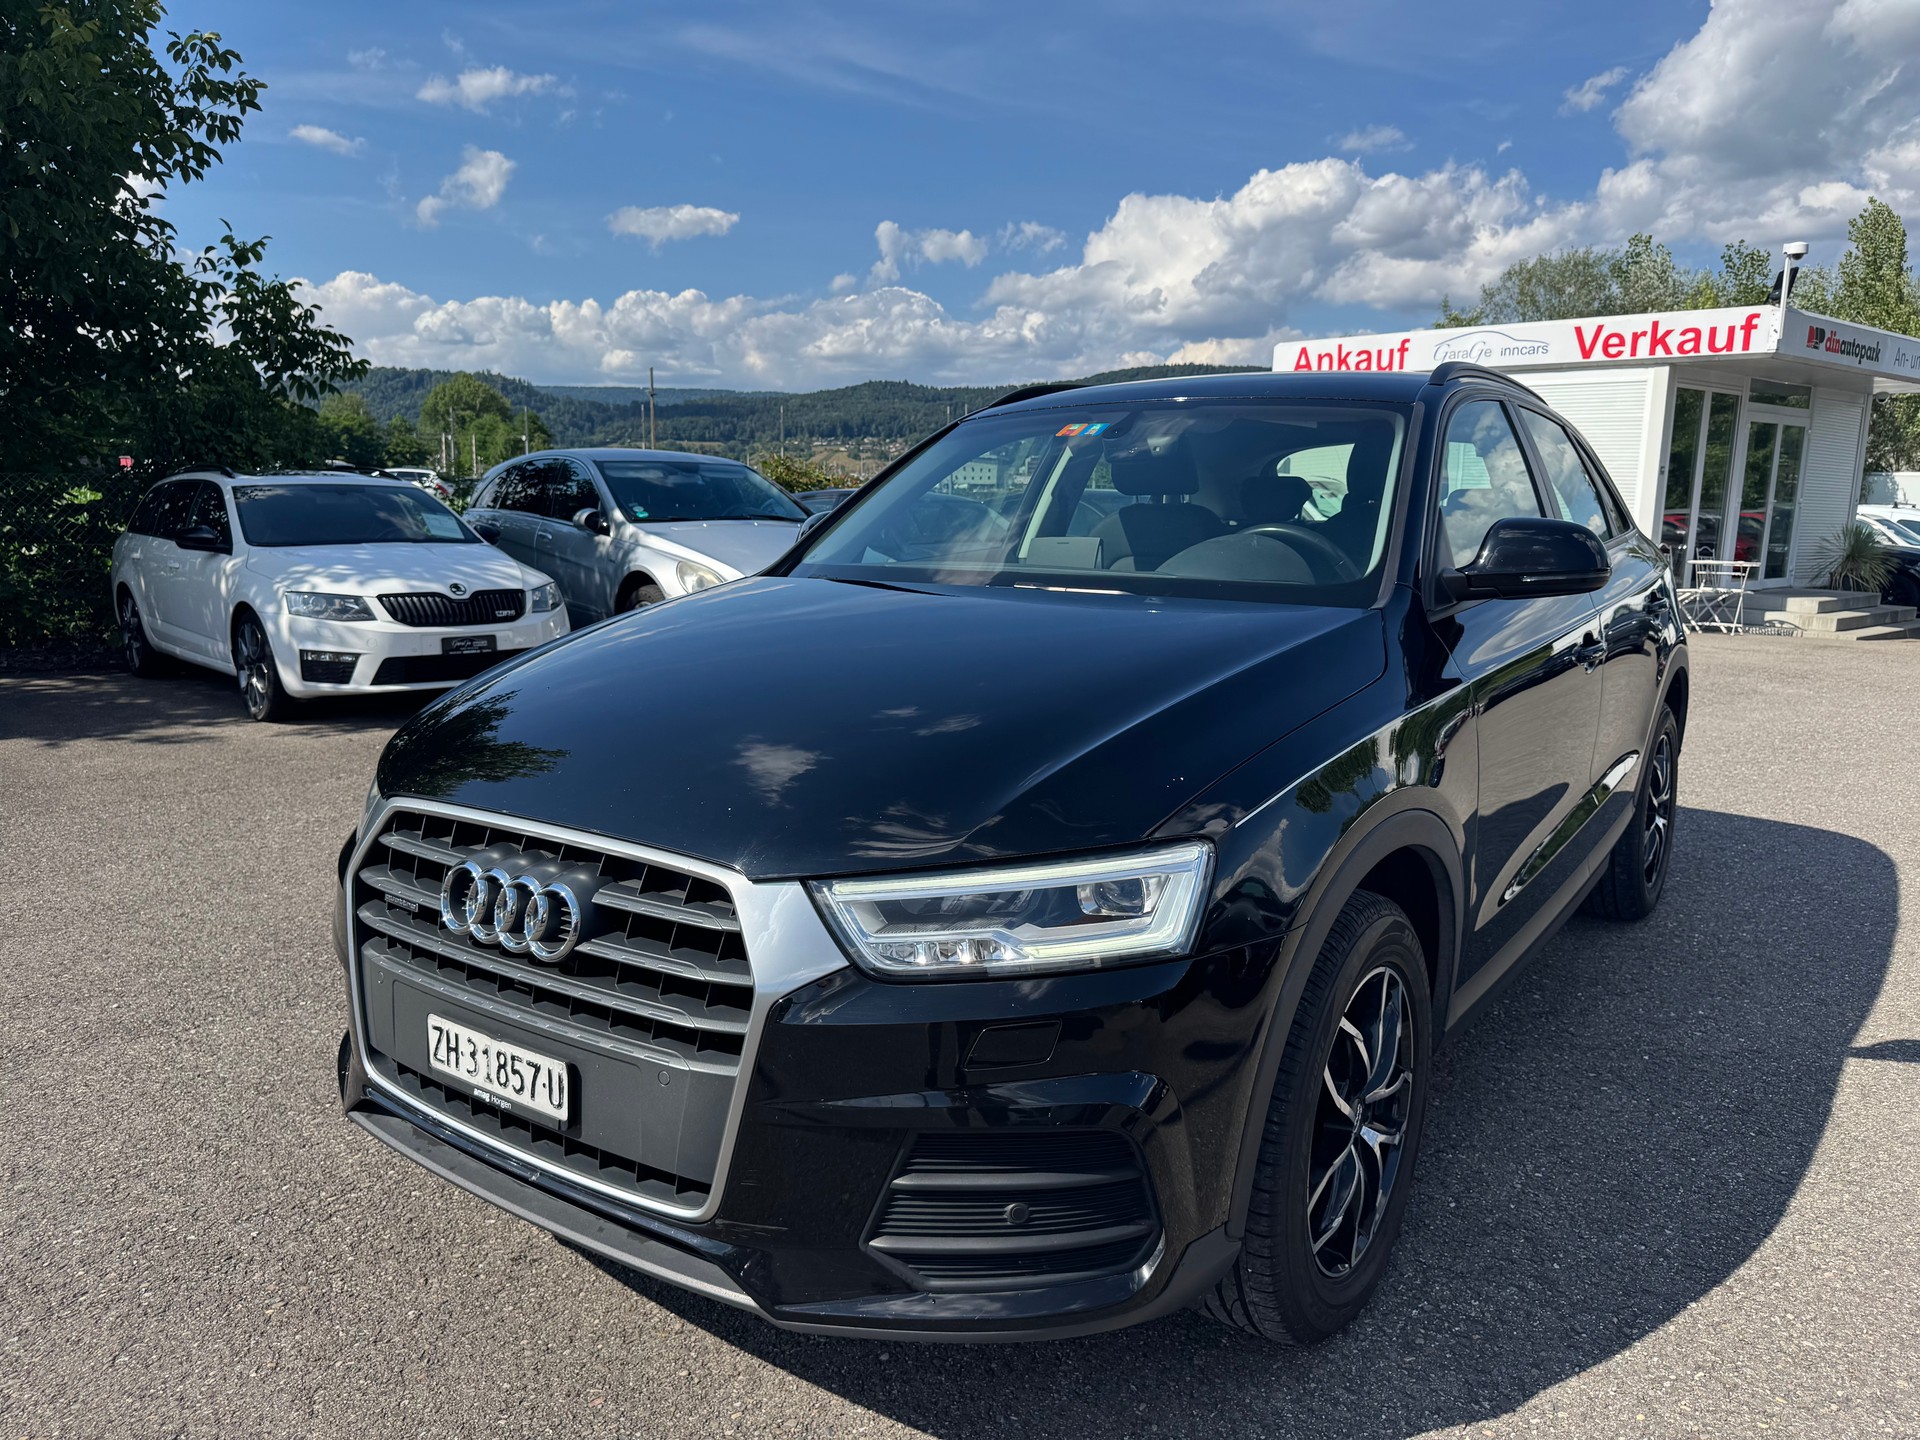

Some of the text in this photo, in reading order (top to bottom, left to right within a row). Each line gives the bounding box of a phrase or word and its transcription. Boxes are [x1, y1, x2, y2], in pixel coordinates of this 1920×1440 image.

[1574, 312, 1761, 360] Verkauf
[1825, 330, 1881, 364] dinautopark
[1294, 338, 1410, 371] Ankauf
[1500, 344, 1549, 358] inncars
[1893, 346, 1909, 368] An-
[473, 1088, 512, 1110] amag Horgen
